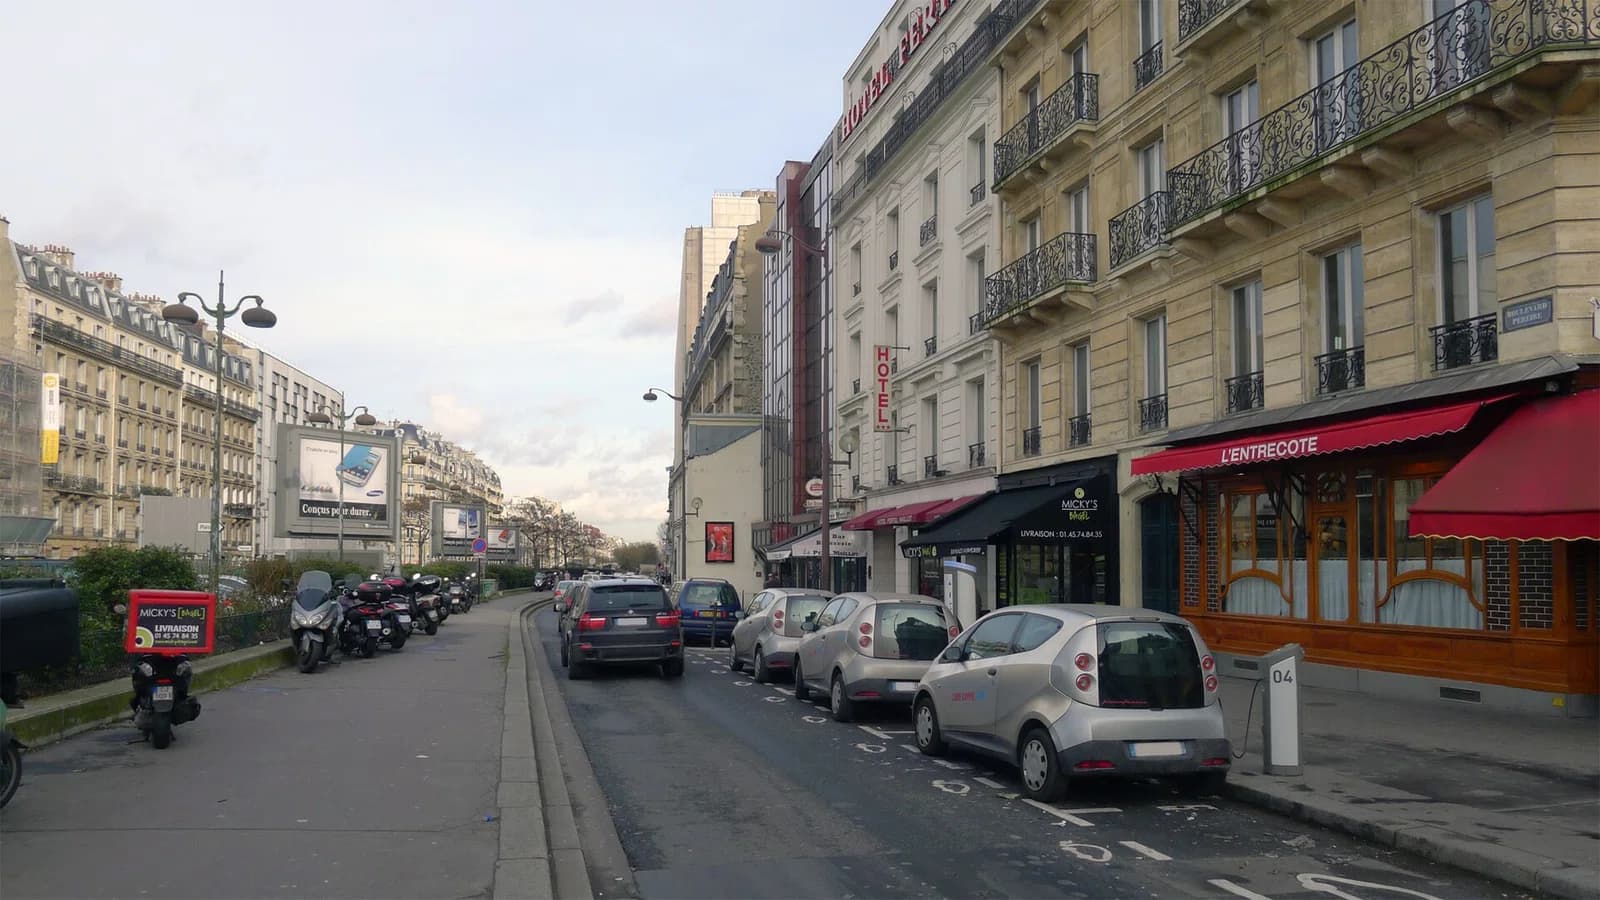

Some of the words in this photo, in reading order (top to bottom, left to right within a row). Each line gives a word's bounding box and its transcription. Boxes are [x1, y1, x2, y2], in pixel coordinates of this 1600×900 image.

[841, 63, 893, 142] HOTEL
[878, 347, 889, 422] HOTEL
[1221, 436, 1318, 462] L'ENTRECOTE
[302, 504, 330, 516] Conçus
[1061, 500, 1098, 509] MICKY'S
[1020, 530, 1055, 538] LIVRAISON
[140, 608, 176, 618] MICKY'S
[1273, 670, 1293, 684] 04
